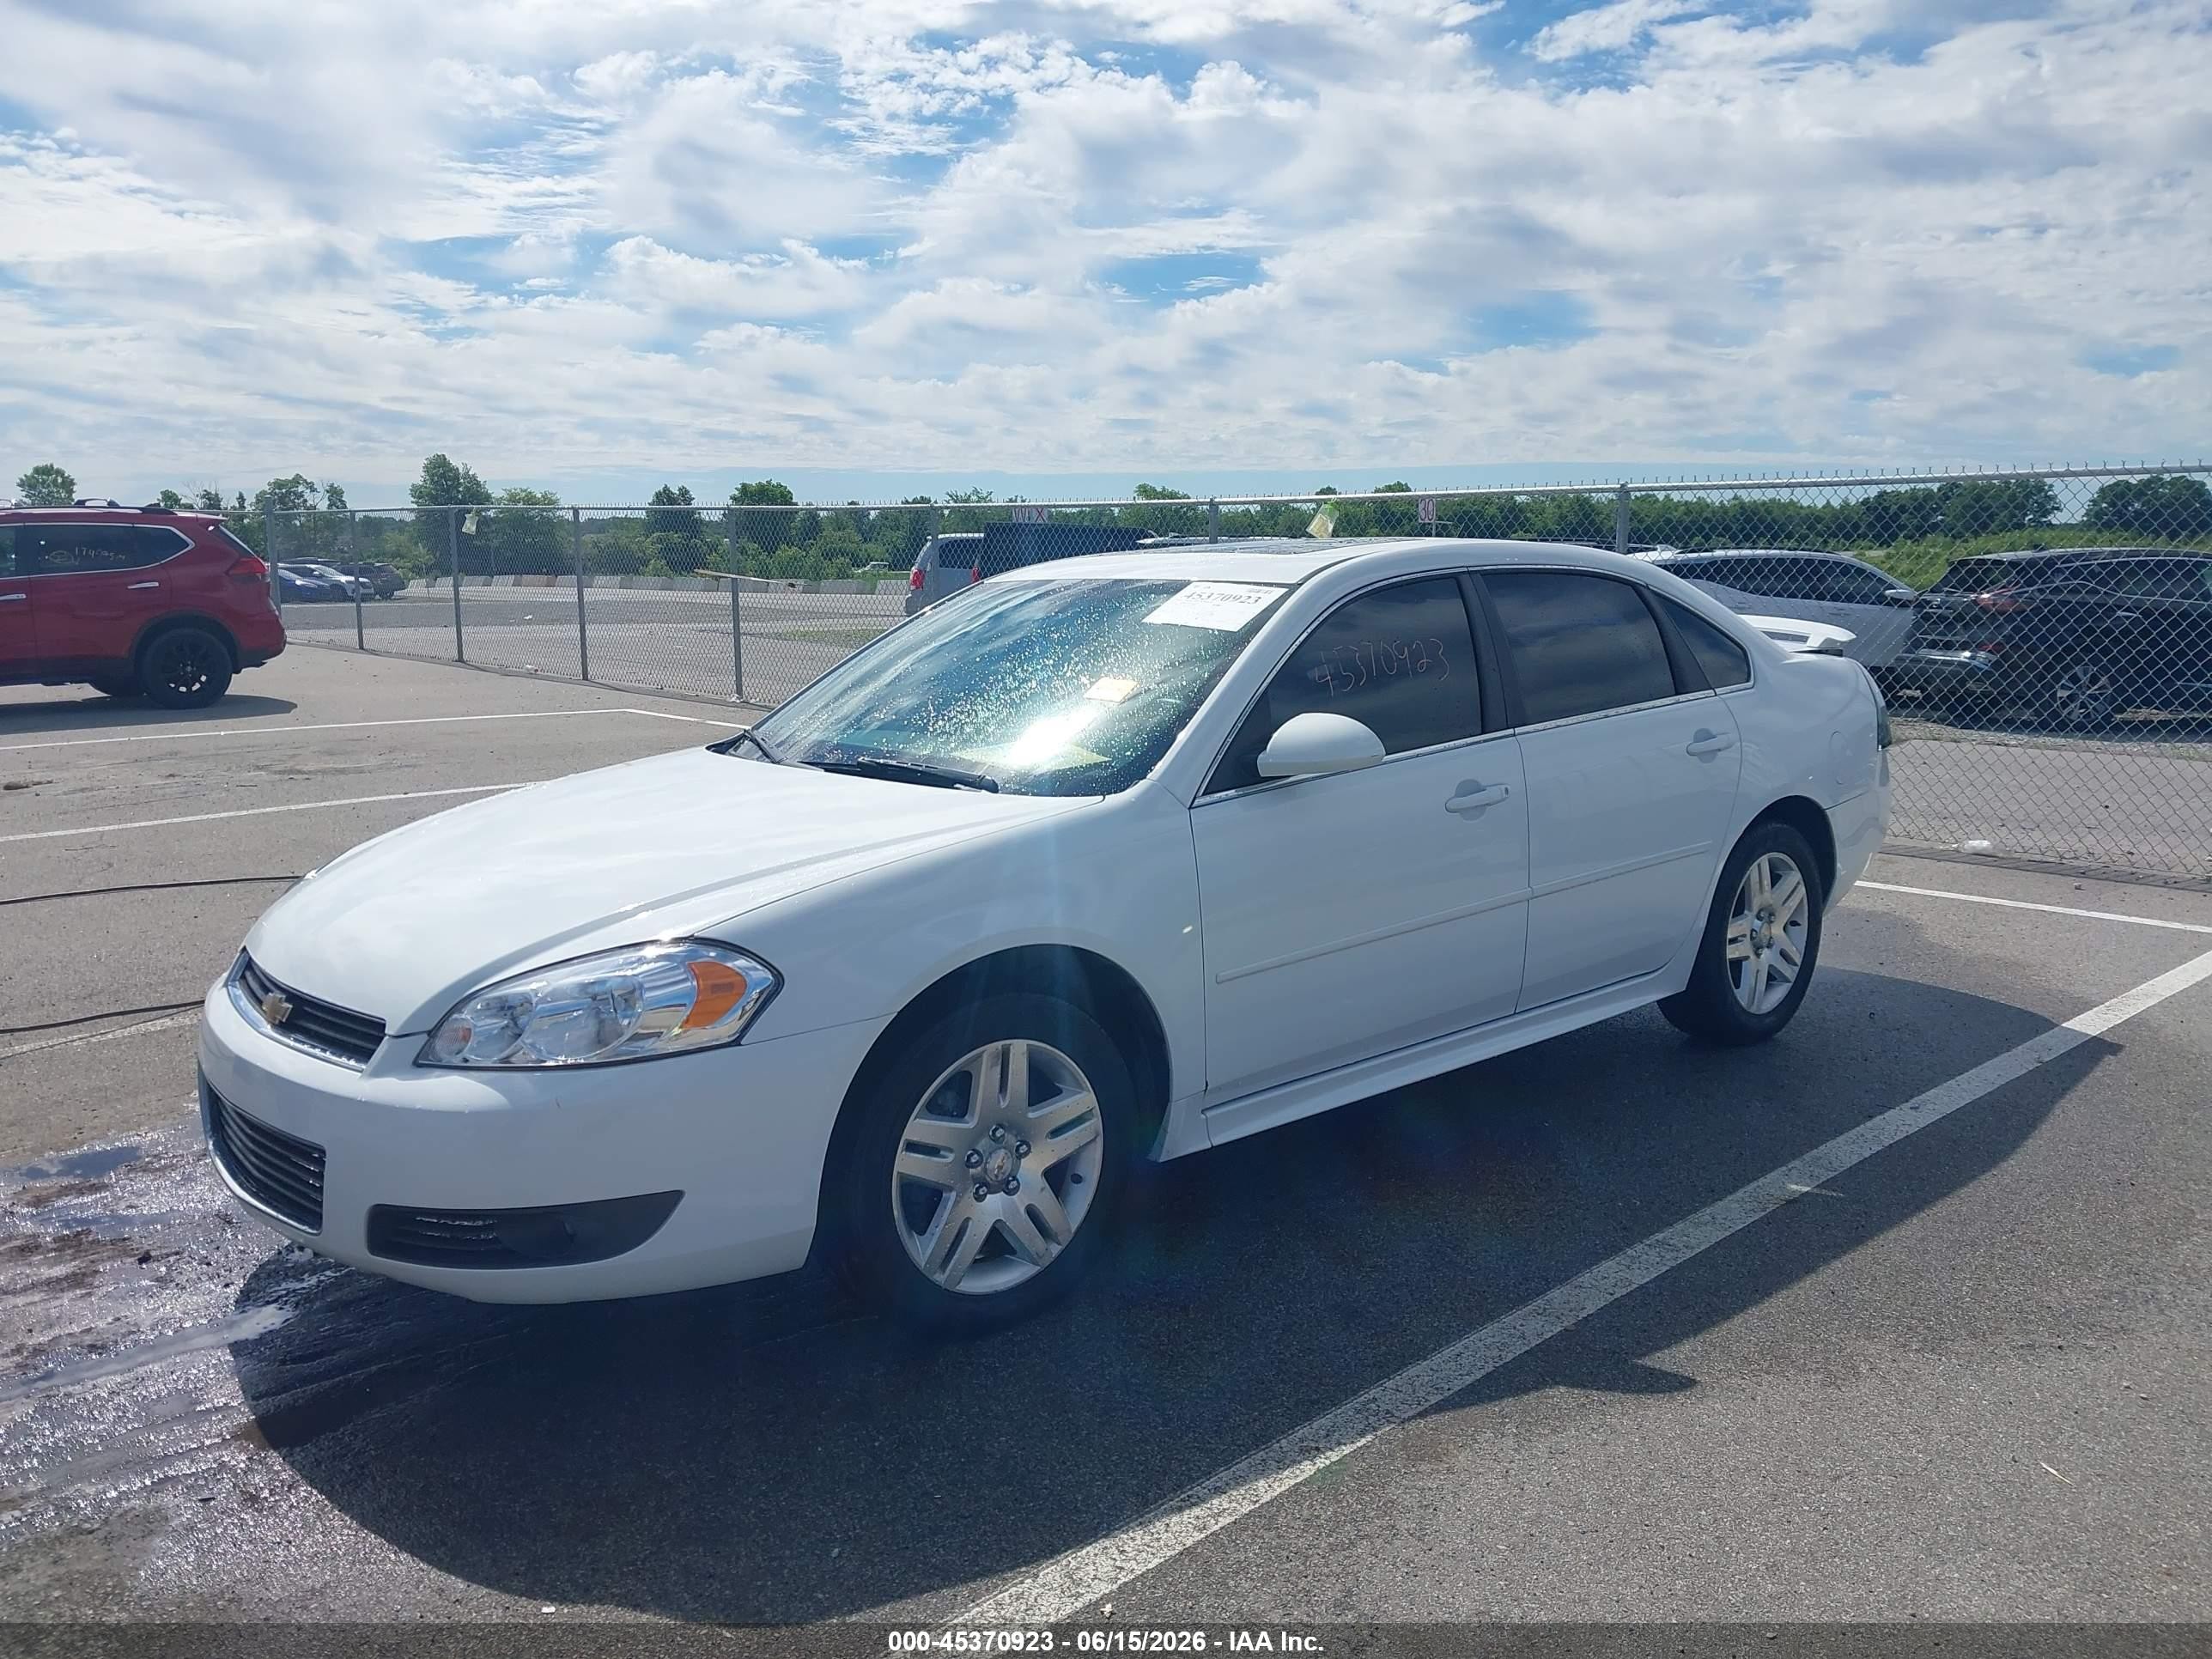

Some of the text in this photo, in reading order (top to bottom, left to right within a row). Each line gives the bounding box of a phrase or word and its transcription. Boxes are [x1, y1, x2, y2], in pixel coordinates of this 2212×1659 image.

[1419, 498, 1434, 521] 30
[1184, 591, 1262, 605] 45370923
[1316, 638, 1449, 696] 45370923
